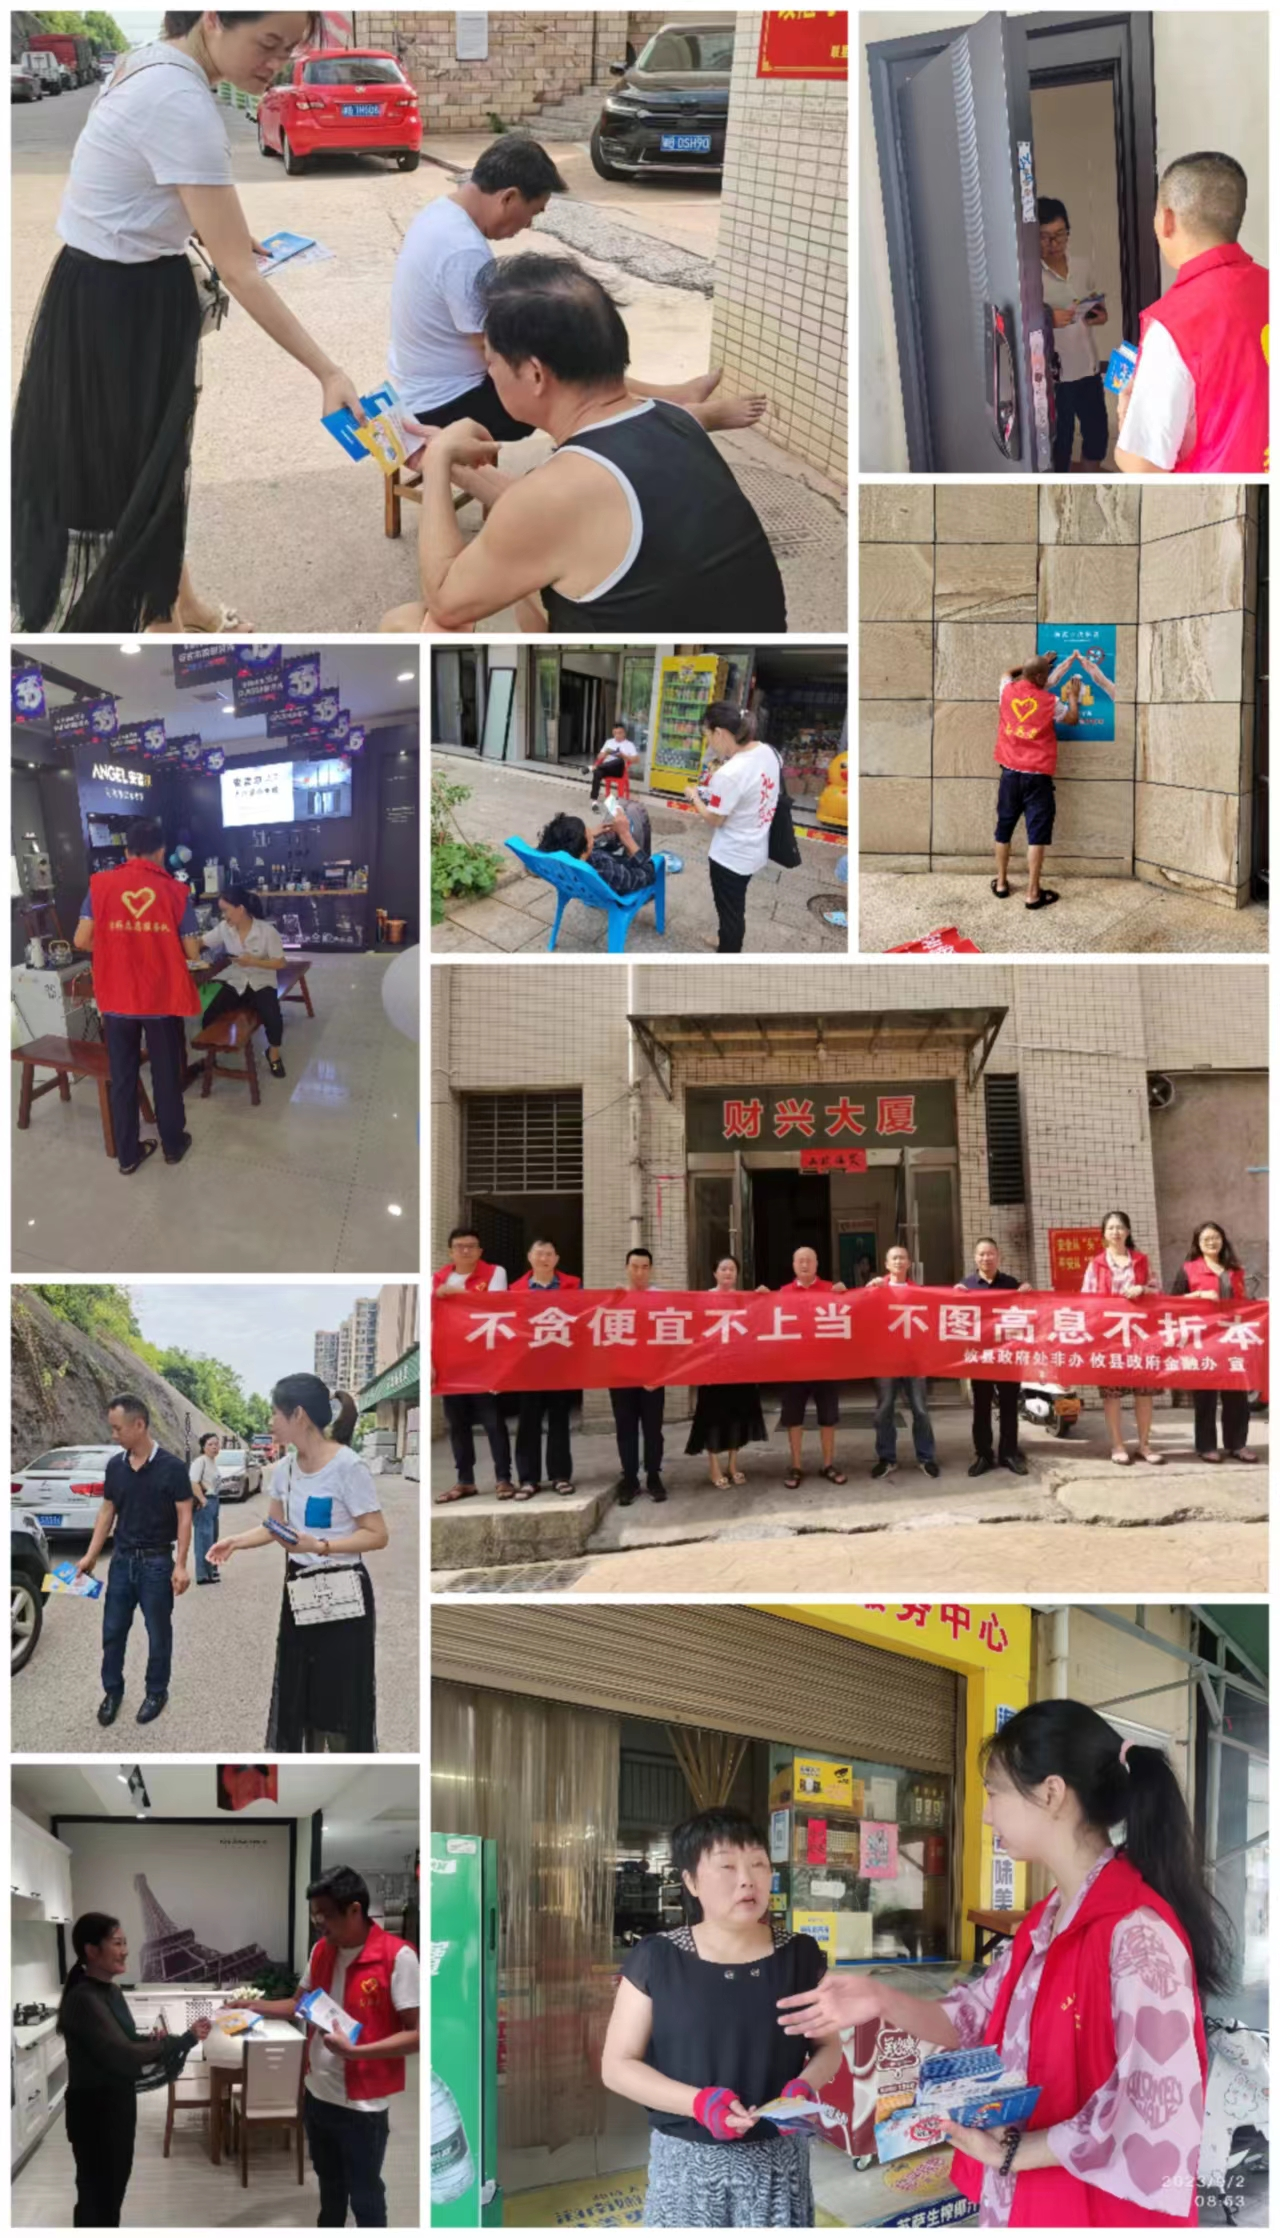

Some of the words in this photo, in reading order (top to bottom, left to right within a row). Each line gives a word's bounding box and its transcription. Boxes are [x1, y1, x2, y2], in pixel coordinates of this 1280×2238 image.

[92, 763, 129, 785] ANGEL
[722, 1095, 918, 1139] 财兴大厦
[464, 1302, 853, 1351] 不贪便宜不上当
[887, 1304, 1265, 1351] 不图高息不折本
[963, 1349, 1085, 1368] 攸县政府处非办
[1089, 1352, 1218, 1373] 攸县政府金融办
[1227, 1356, 1246, 1373] 宣
[864, 1604, 1009, 1653] 务中心
